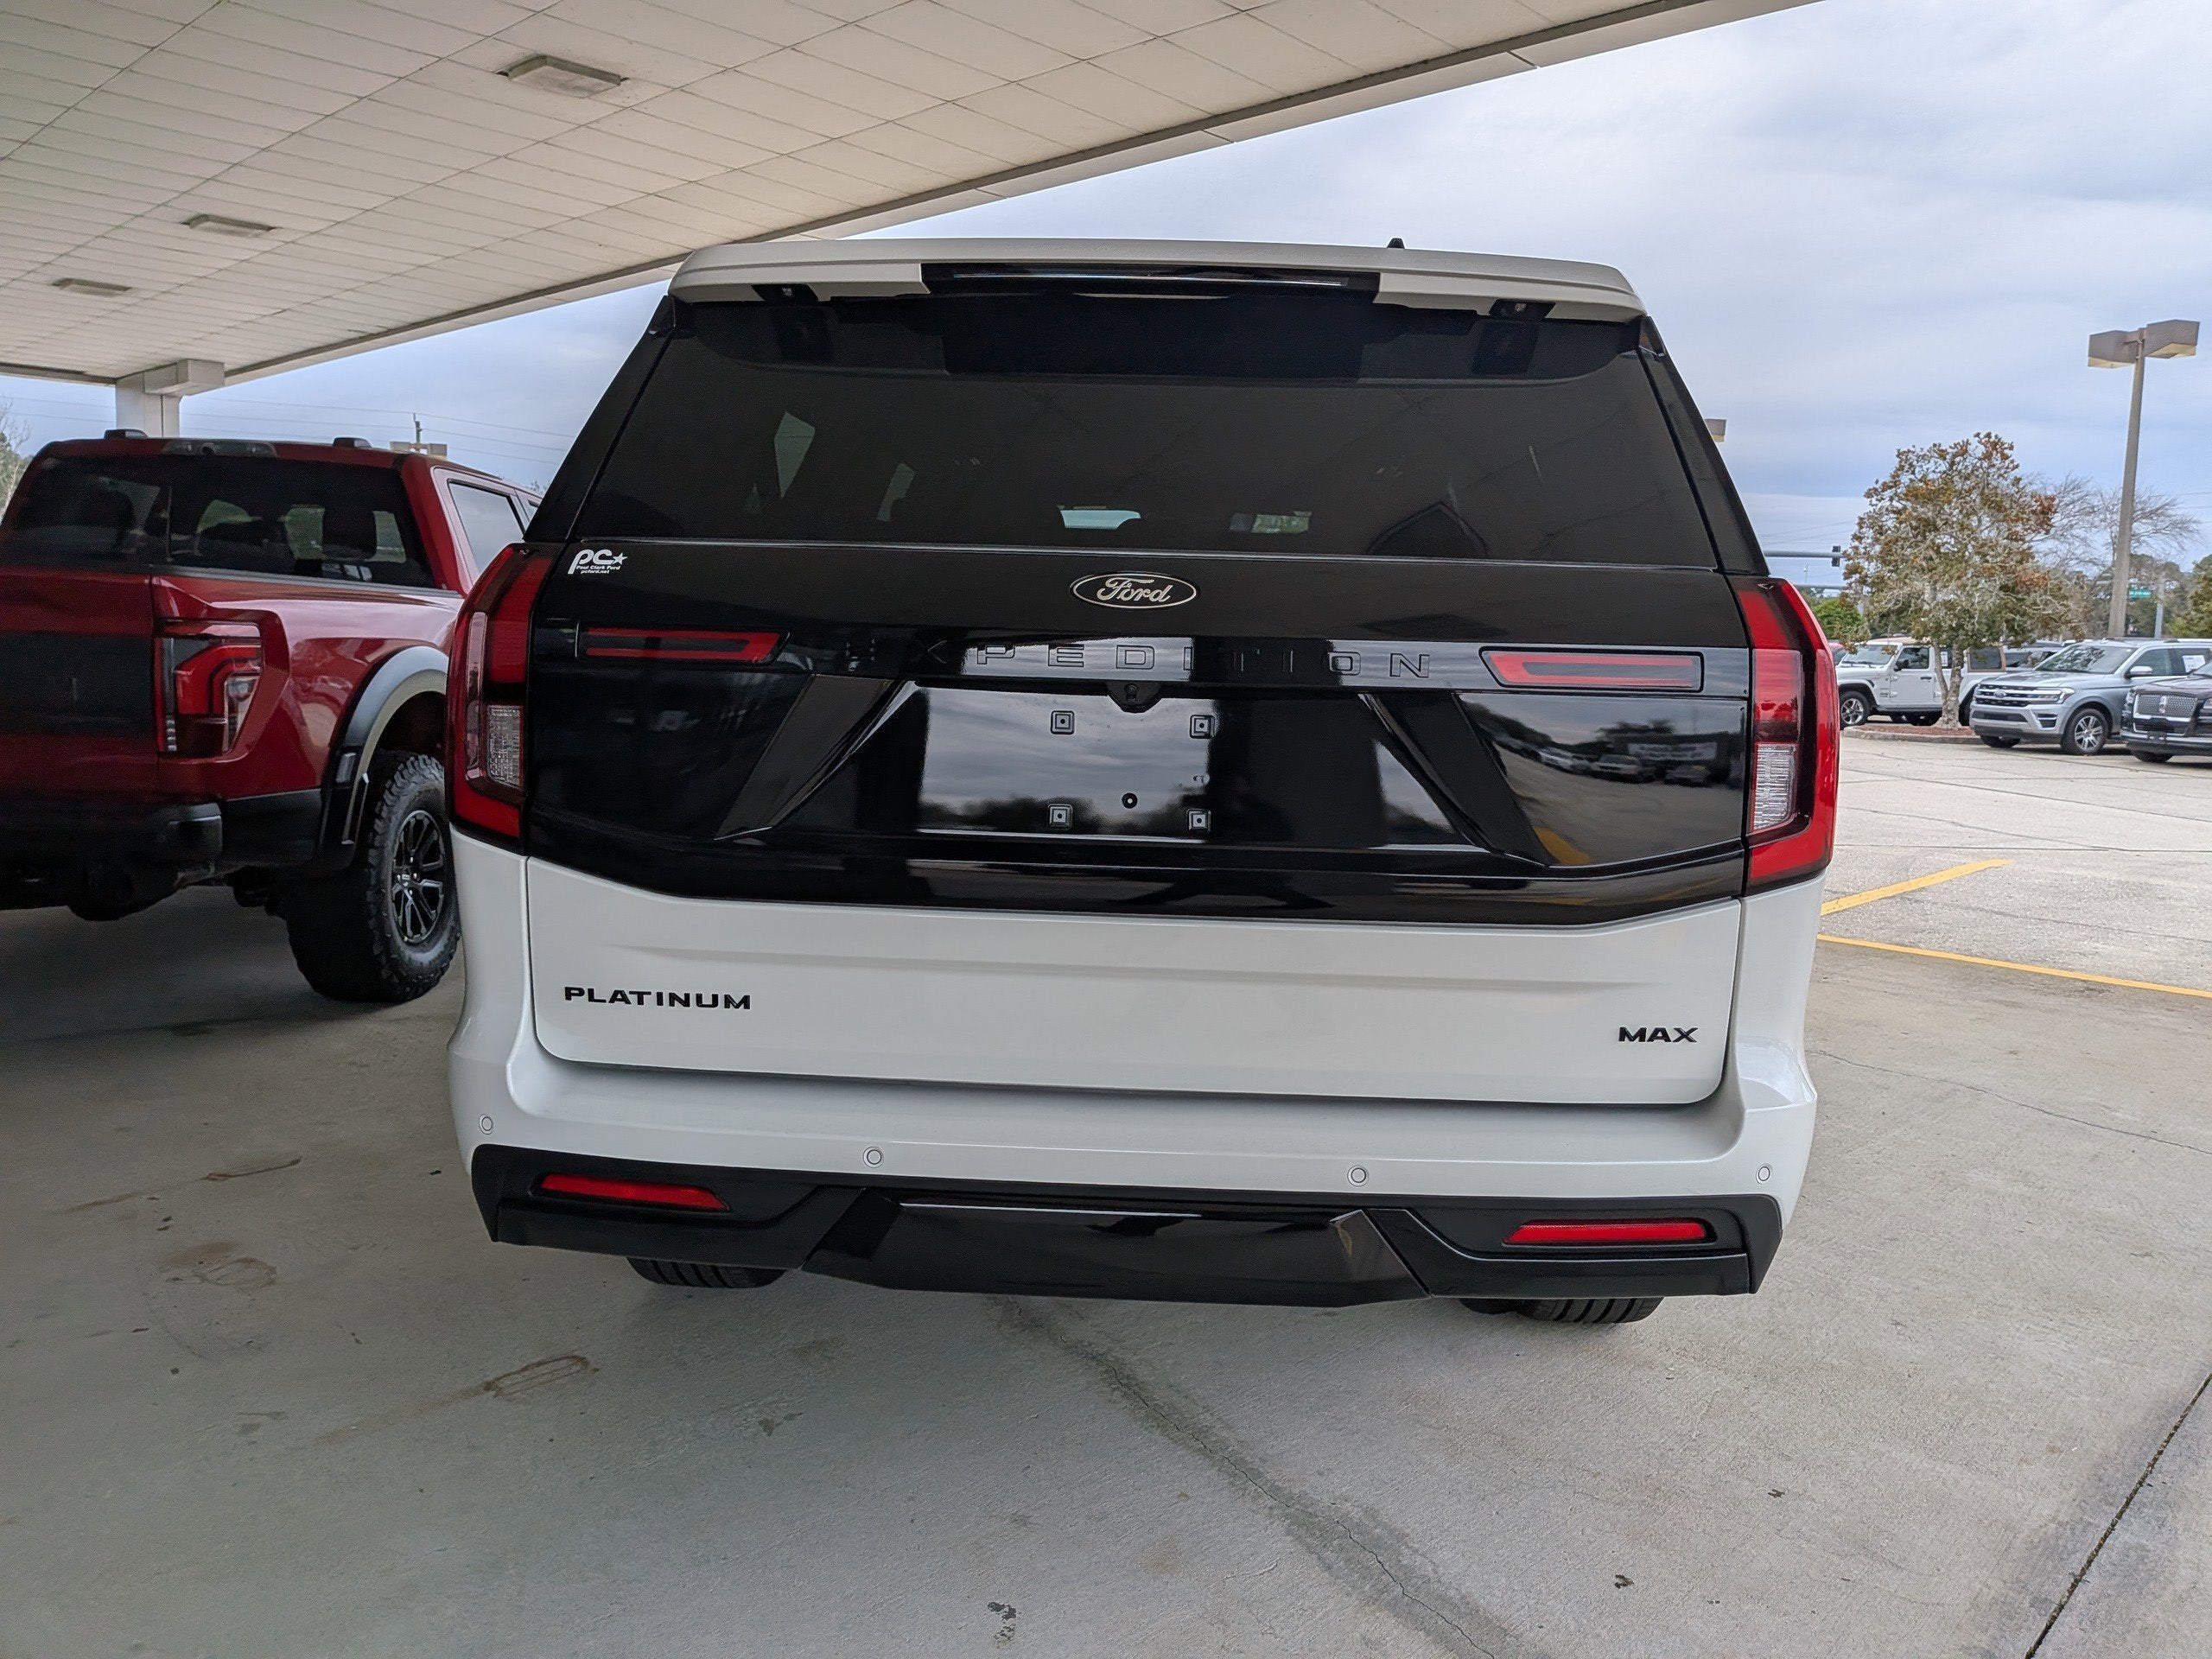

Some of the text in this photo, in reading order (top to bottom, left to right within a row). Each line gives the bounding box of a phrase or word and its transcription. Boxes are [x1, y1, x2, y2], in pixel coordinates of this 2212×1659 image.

[1096, 576, 1173, 602] Ford
[846, 639, 1429, 678] XPEDIION
[564, 986, 751, 1010] PLATINUM
[1618, 1027, 1699, 1042] MAX
